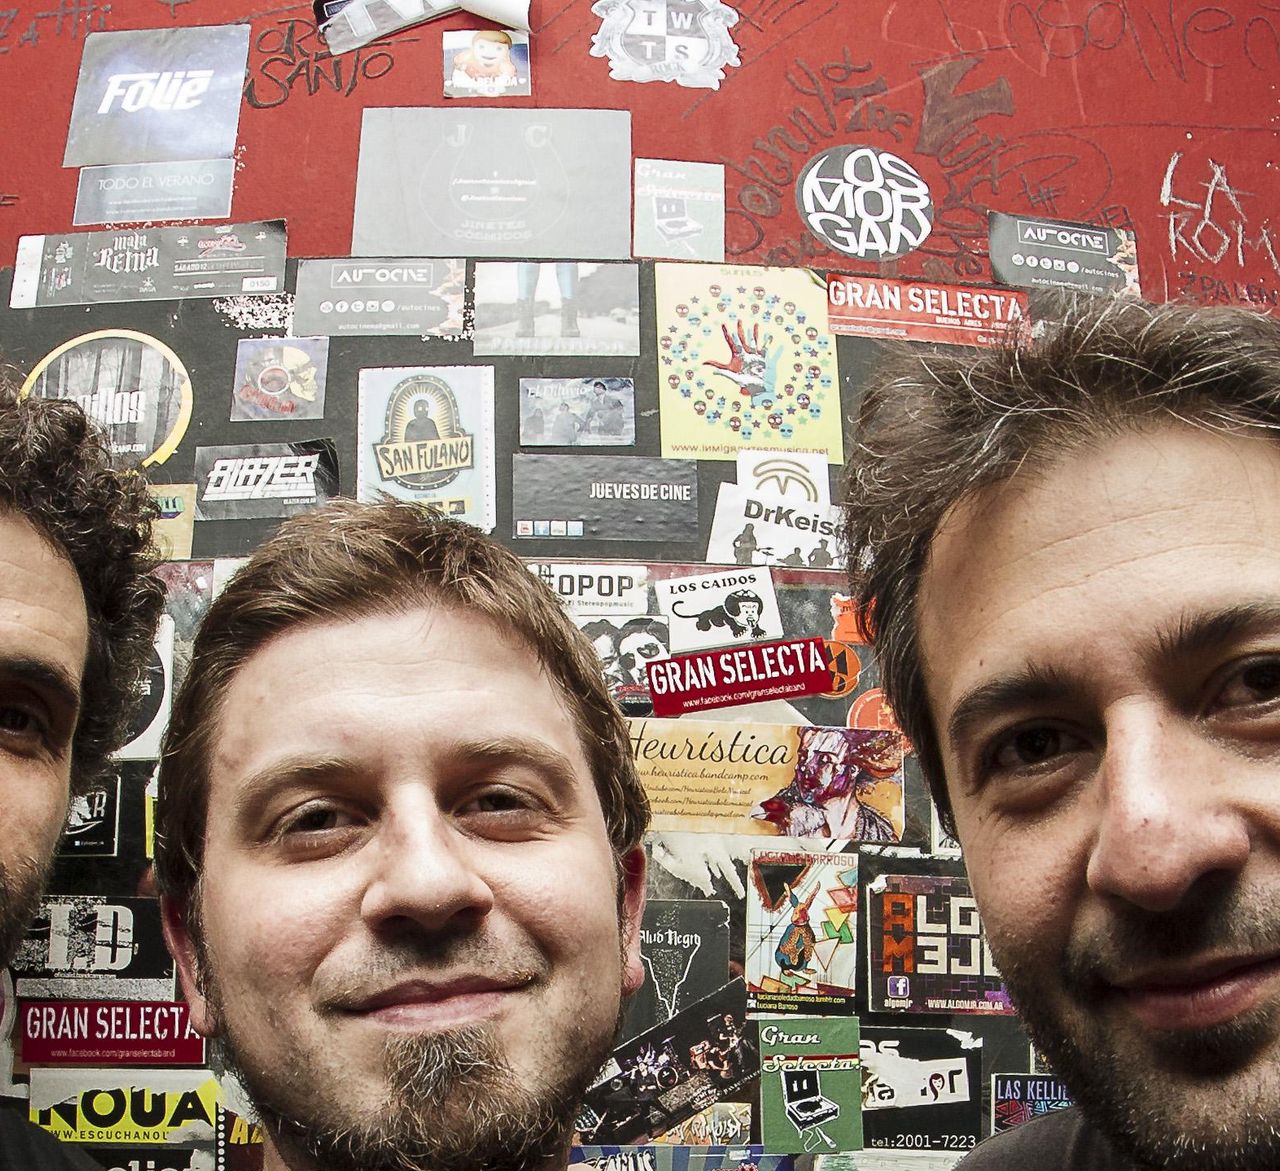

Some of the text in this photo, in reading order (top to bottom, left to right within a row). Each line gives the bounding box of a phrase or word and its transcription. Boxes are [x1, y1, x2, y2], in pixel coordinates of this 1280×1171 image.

[98, 172, 216, 192] TODO EL VERANO
[1159, 152, 1253, 222] LA
[828, 279, 1024, 322] GRAN SELECTA
[379, 438, 470, 477] SAN FULANO
[590, 482, 692, 501] JUEVES DE CINE
[669, 574, 758, 595] LOS CAIDOS
[650, 655, 717, 695] GRAN
[720, 641, 826, 685] SELECTA
[625, 720, 795, 766] Heurística
[26, 1006, 201, 1041] GRAN SELECTA
[761, 1024, 821, 1047] Gran
[997, 1079, 1022, 1100] LAS
